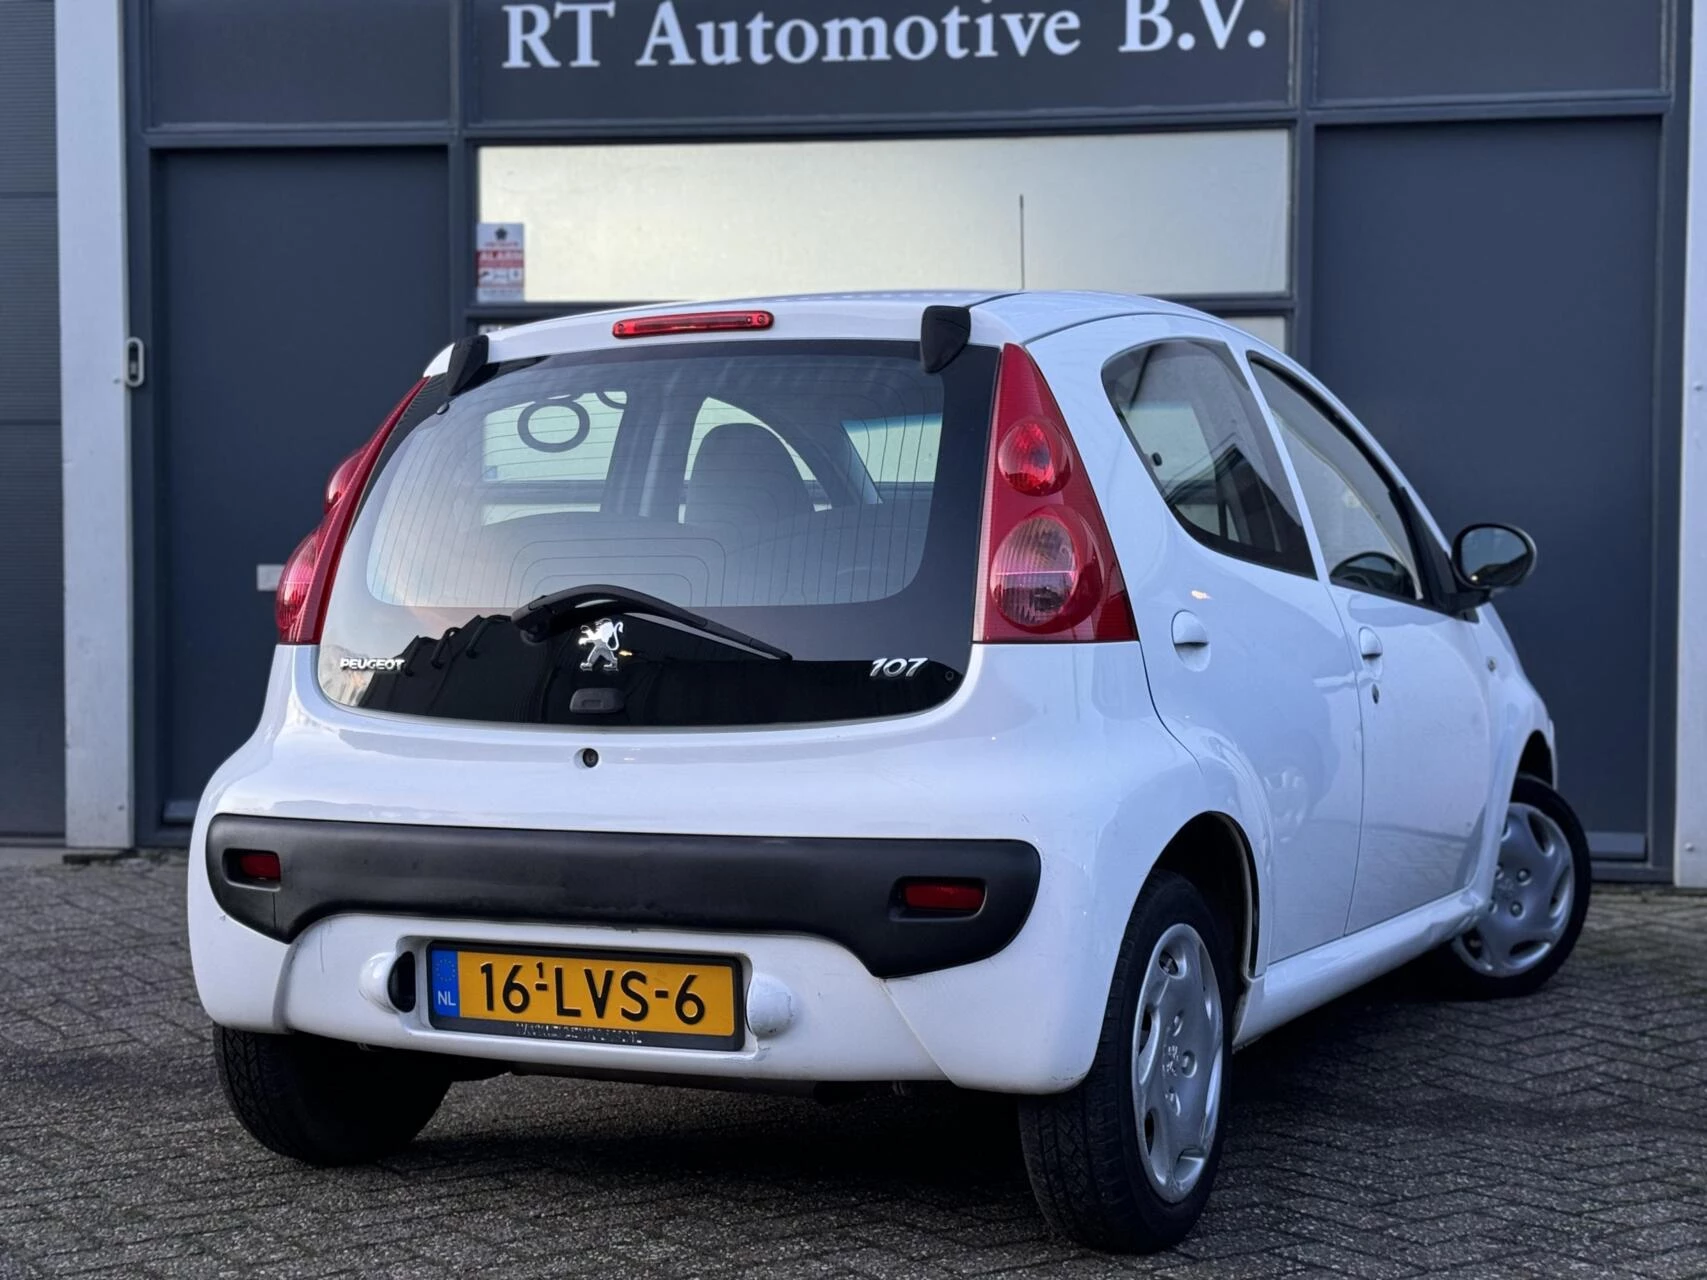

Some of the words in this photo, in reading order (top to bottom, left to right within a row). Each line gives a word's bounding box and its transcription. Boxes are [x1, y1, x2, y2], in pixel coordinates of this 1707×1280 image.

[502, 1, 616, 68] RT
[635, 0, 1081, 67] Automotive
[1118, 0, 1266, 53] B.V.
[340, 657, 405, 671] PEUGEOT
[869, 657, 928, 677] 107
[437, 990, 457, 1006] NL
